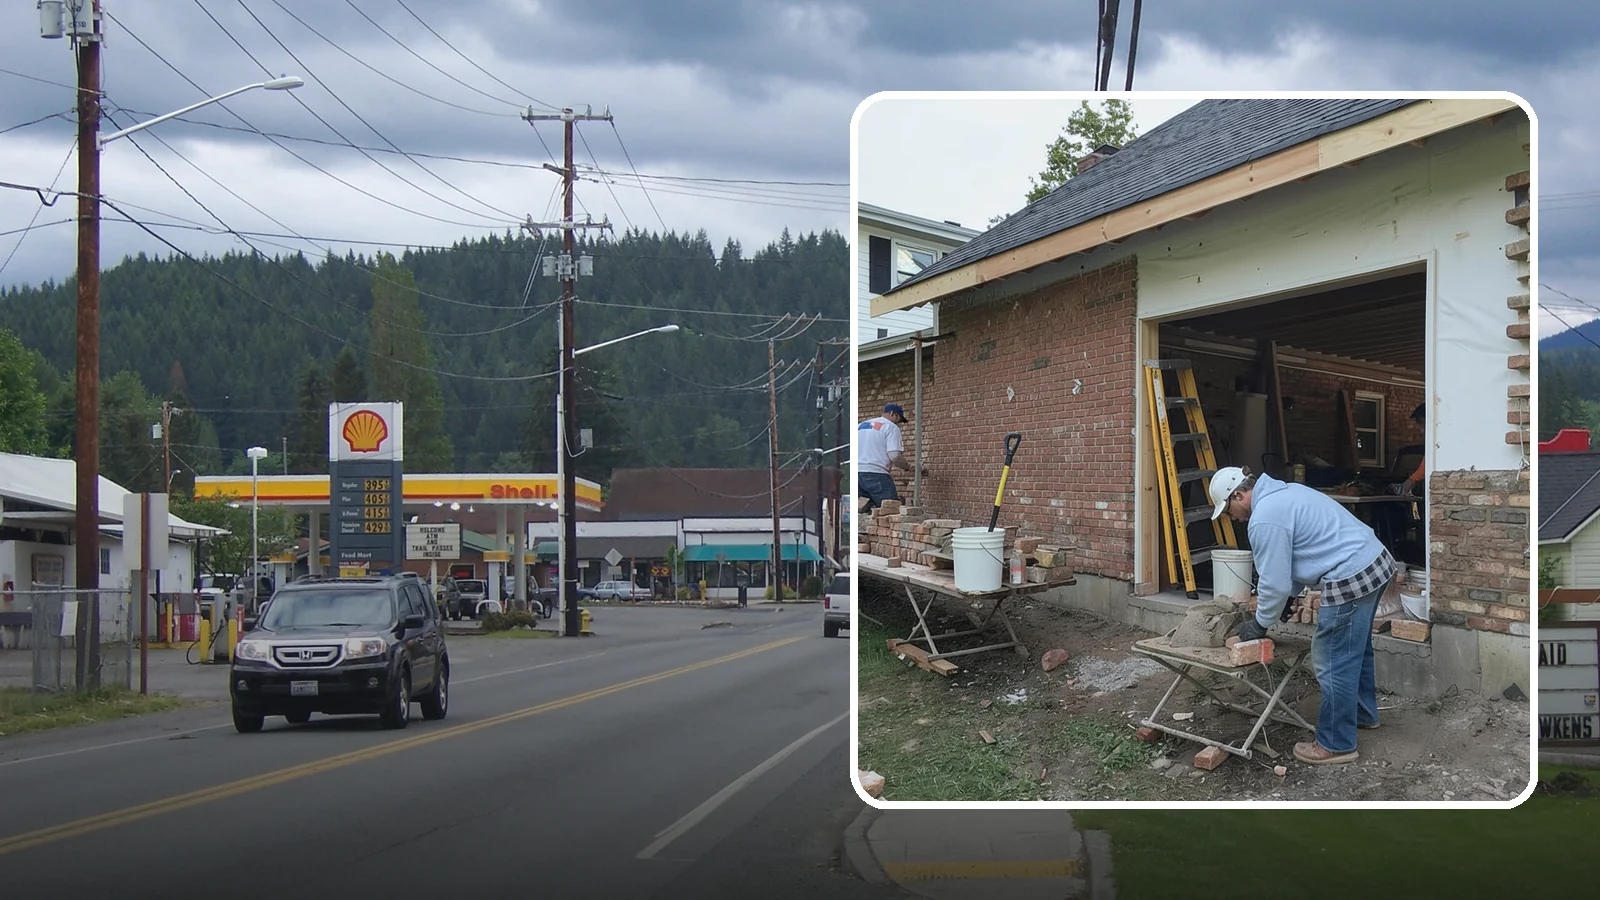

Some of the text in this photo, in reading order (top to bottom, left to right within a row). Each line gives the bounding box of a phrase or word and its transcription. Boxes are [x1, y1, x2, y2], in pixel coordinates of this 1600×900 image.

[366, 480, 384, 490] 395
[490, 484, 547, 499] Shell
[366, 494, 384, 504] 405
[366, 508, 384, 518] 415
[366, 522, 384, 532] 429
